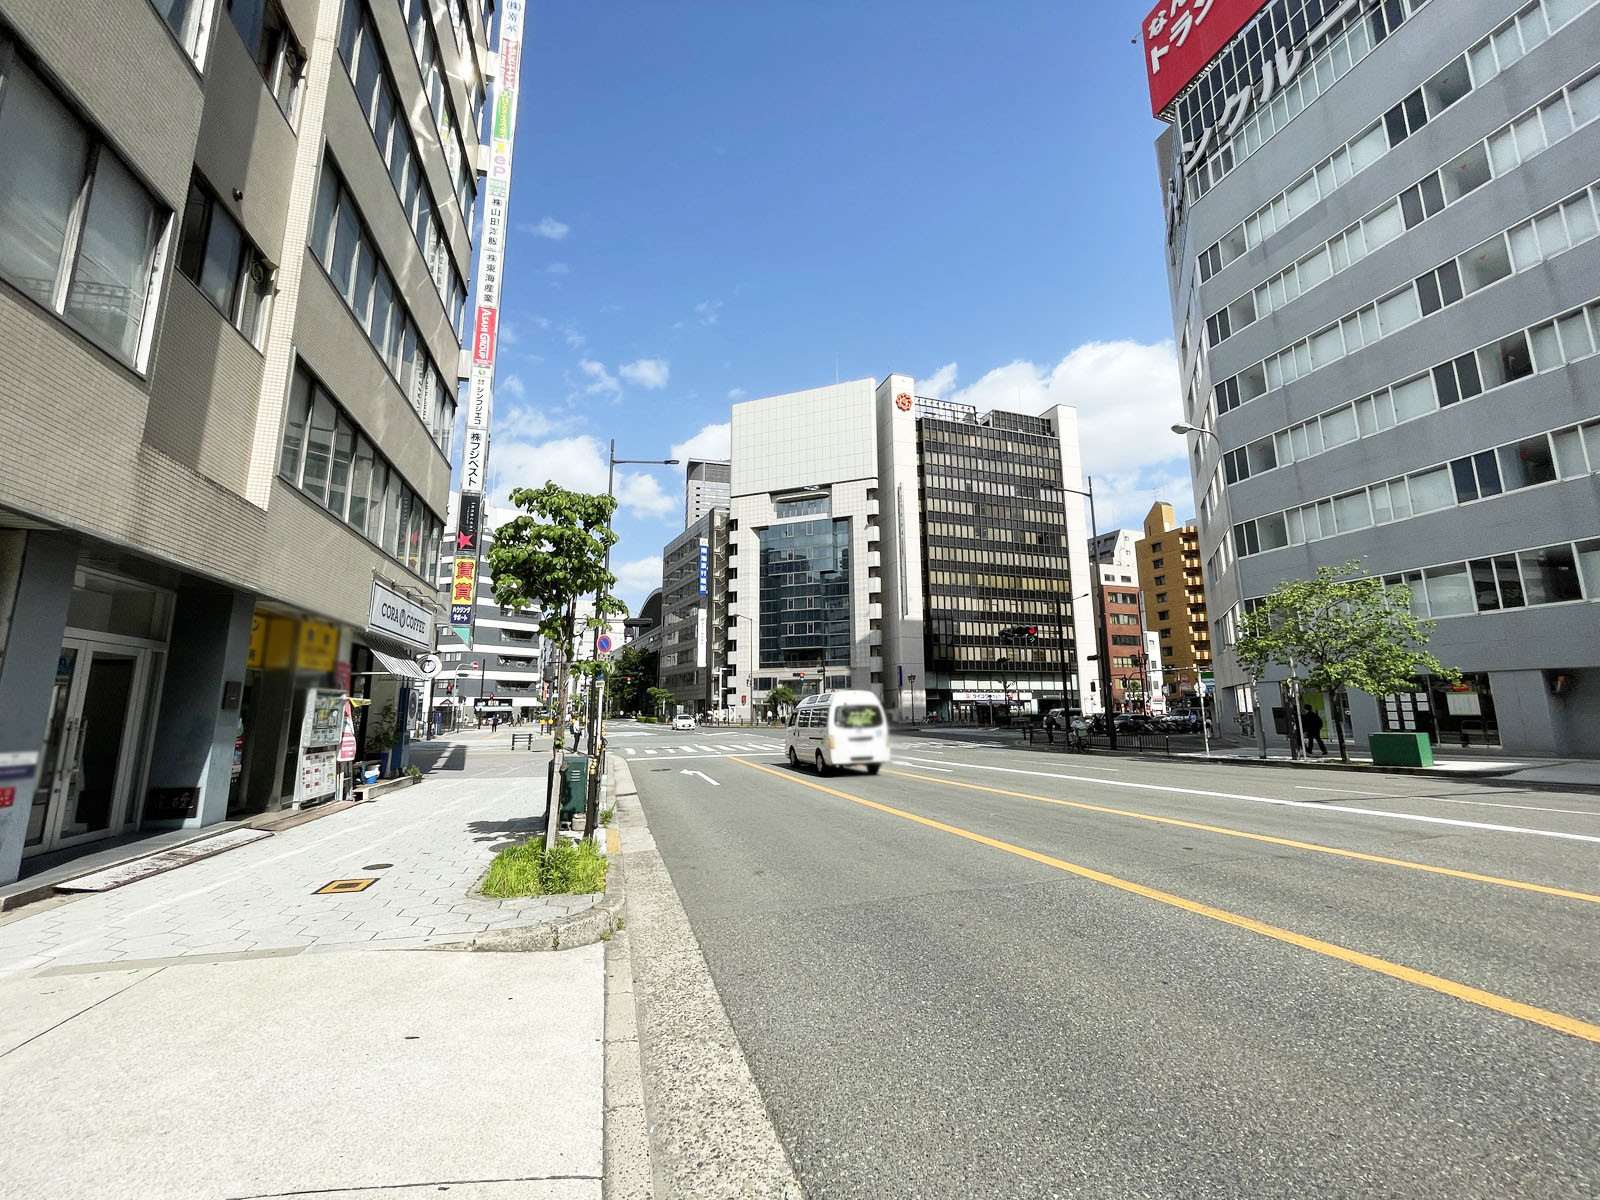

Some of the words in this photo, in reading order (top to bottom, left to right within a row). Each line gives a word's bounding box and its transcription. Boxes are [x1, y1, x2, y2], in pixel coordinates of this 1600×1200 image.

[480, 308, 492, 332] ASAHI
[478, 332, 491, 360] GROUP
[454, 561, 474, 600] 賃貸
[381, 602, 399, 623] CORA
[405, 615, 426, 634] COFFEE
